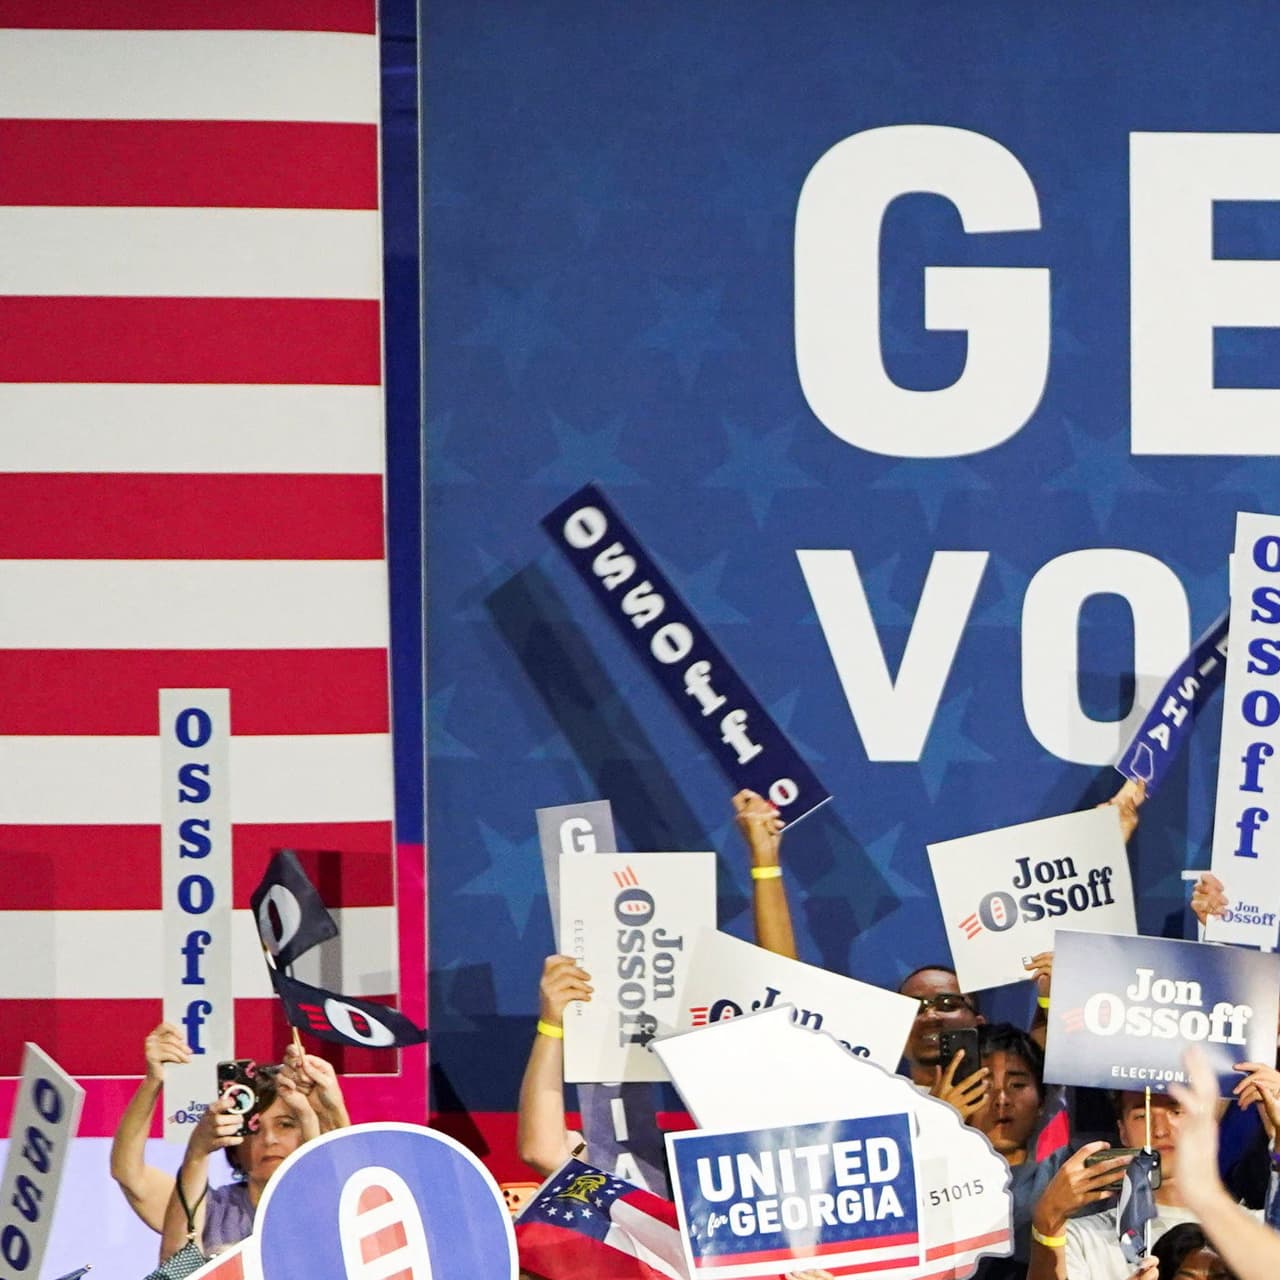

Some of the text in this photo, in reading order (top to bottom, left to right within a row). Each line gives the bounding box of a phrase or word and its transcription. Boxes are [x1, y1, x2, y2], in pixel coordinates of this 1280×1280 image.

[1012, 855, 1077, 890] Jon
[978, 866, 1115, 933] Ossoff
[1235, 901, 1260, 914] Jon
[613, 887, 660, 1053] Ossoff
[651, 926, 684, 1001] Jon
[1127, 968, 1203, 1006] Jon
[1083, 992, 1254, 1046] Ossoff
[1111, 1065, 1192, 1083] ELECTJON.
[697, 1136, 900, 1203] UNITED
[728, 1185, 904, 1237] GEORGIA
